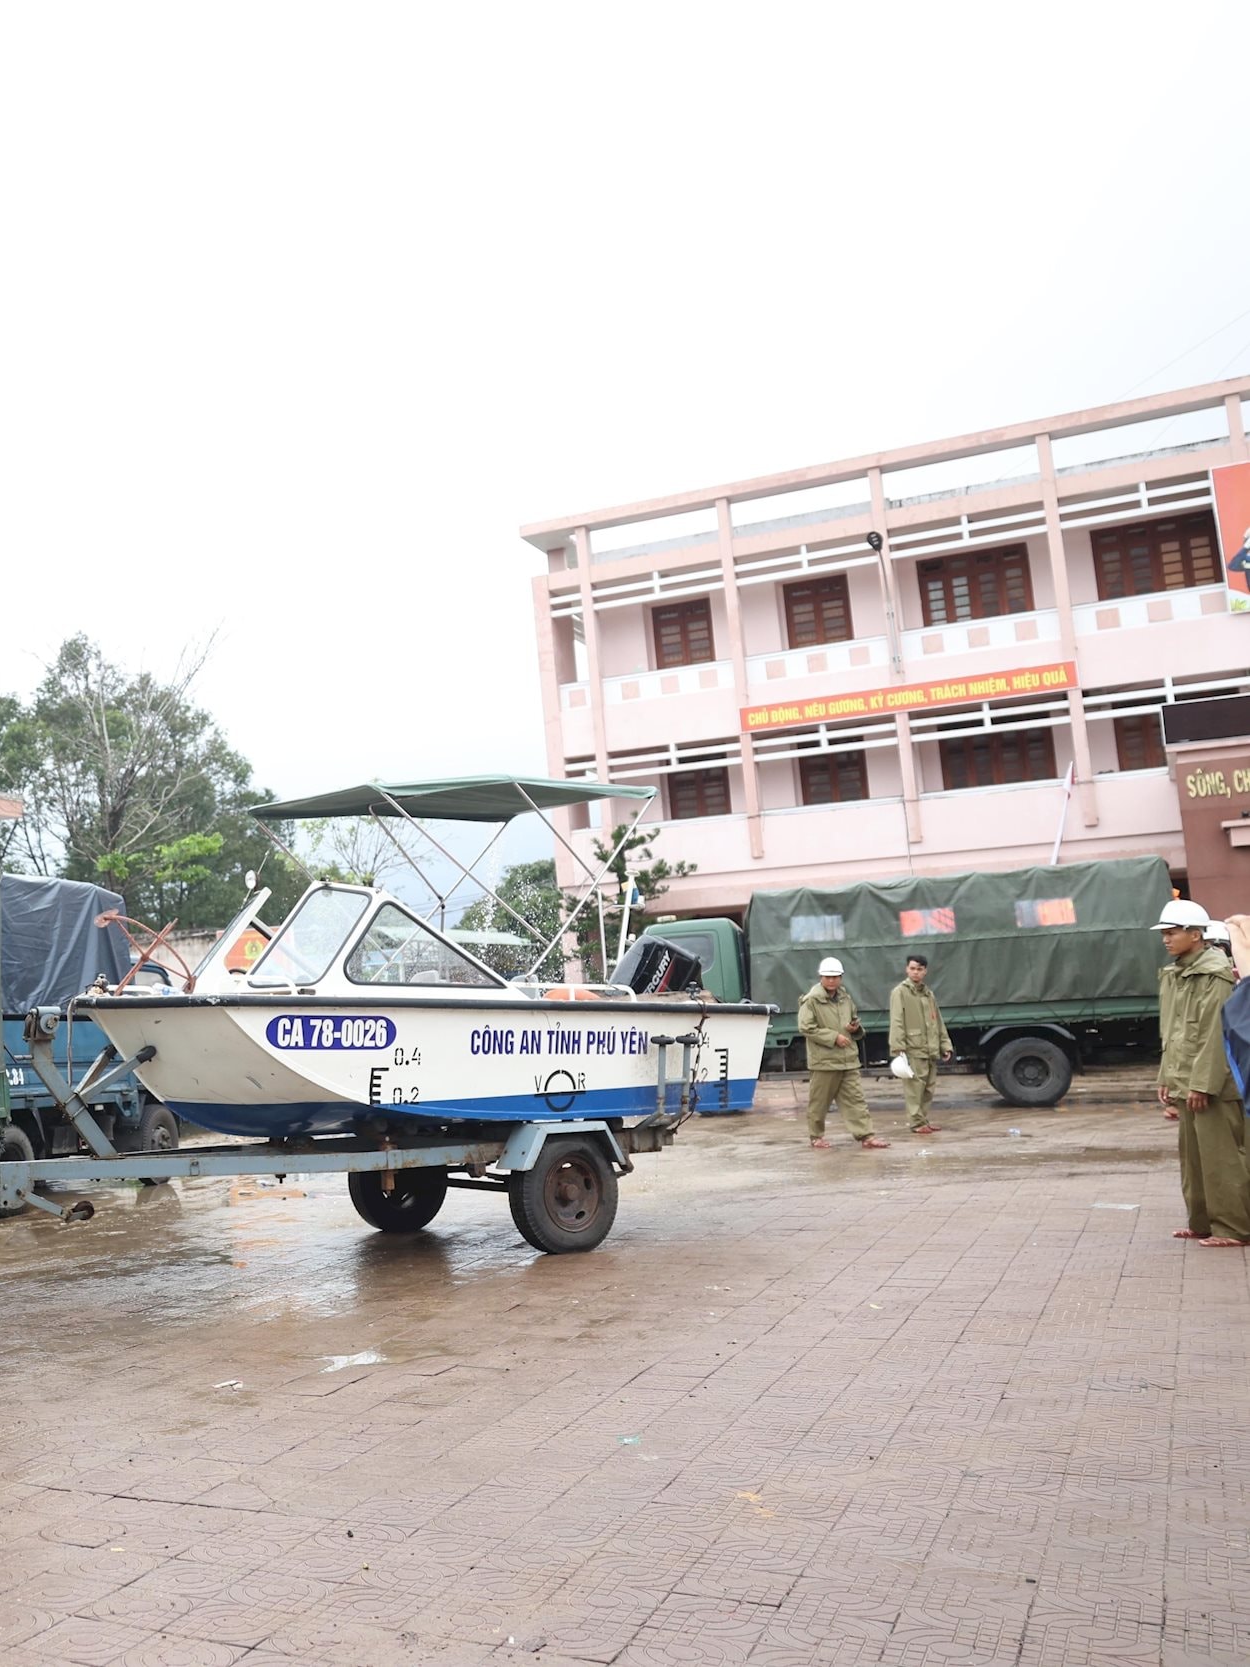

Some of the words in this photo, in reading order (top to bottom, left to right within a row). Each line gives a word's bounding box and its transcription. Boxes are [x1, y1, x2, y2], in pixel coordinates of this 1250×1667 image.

[930, 683, 967, 700] TRÁCH
[1012, 671, 1040, 691] HIỆU
[1042, 665, 1068, 687] QUẢ
[277, 1017, 305, 1047] CA
[309, 1018, 388, 1048] 78-0026
[470, 1025, 515, 1055] CÔNG
[519, 1030, 542, 1055] AN
[547, 1021, 582, 1055] TỈNH
[586, 1026, 616, 1055] PHÚ
[620, 1026, 648, 1055] YÊN
[394, 1047, 421, 1066] 0.4
[393, 1087, 420, 1105] 0.2
